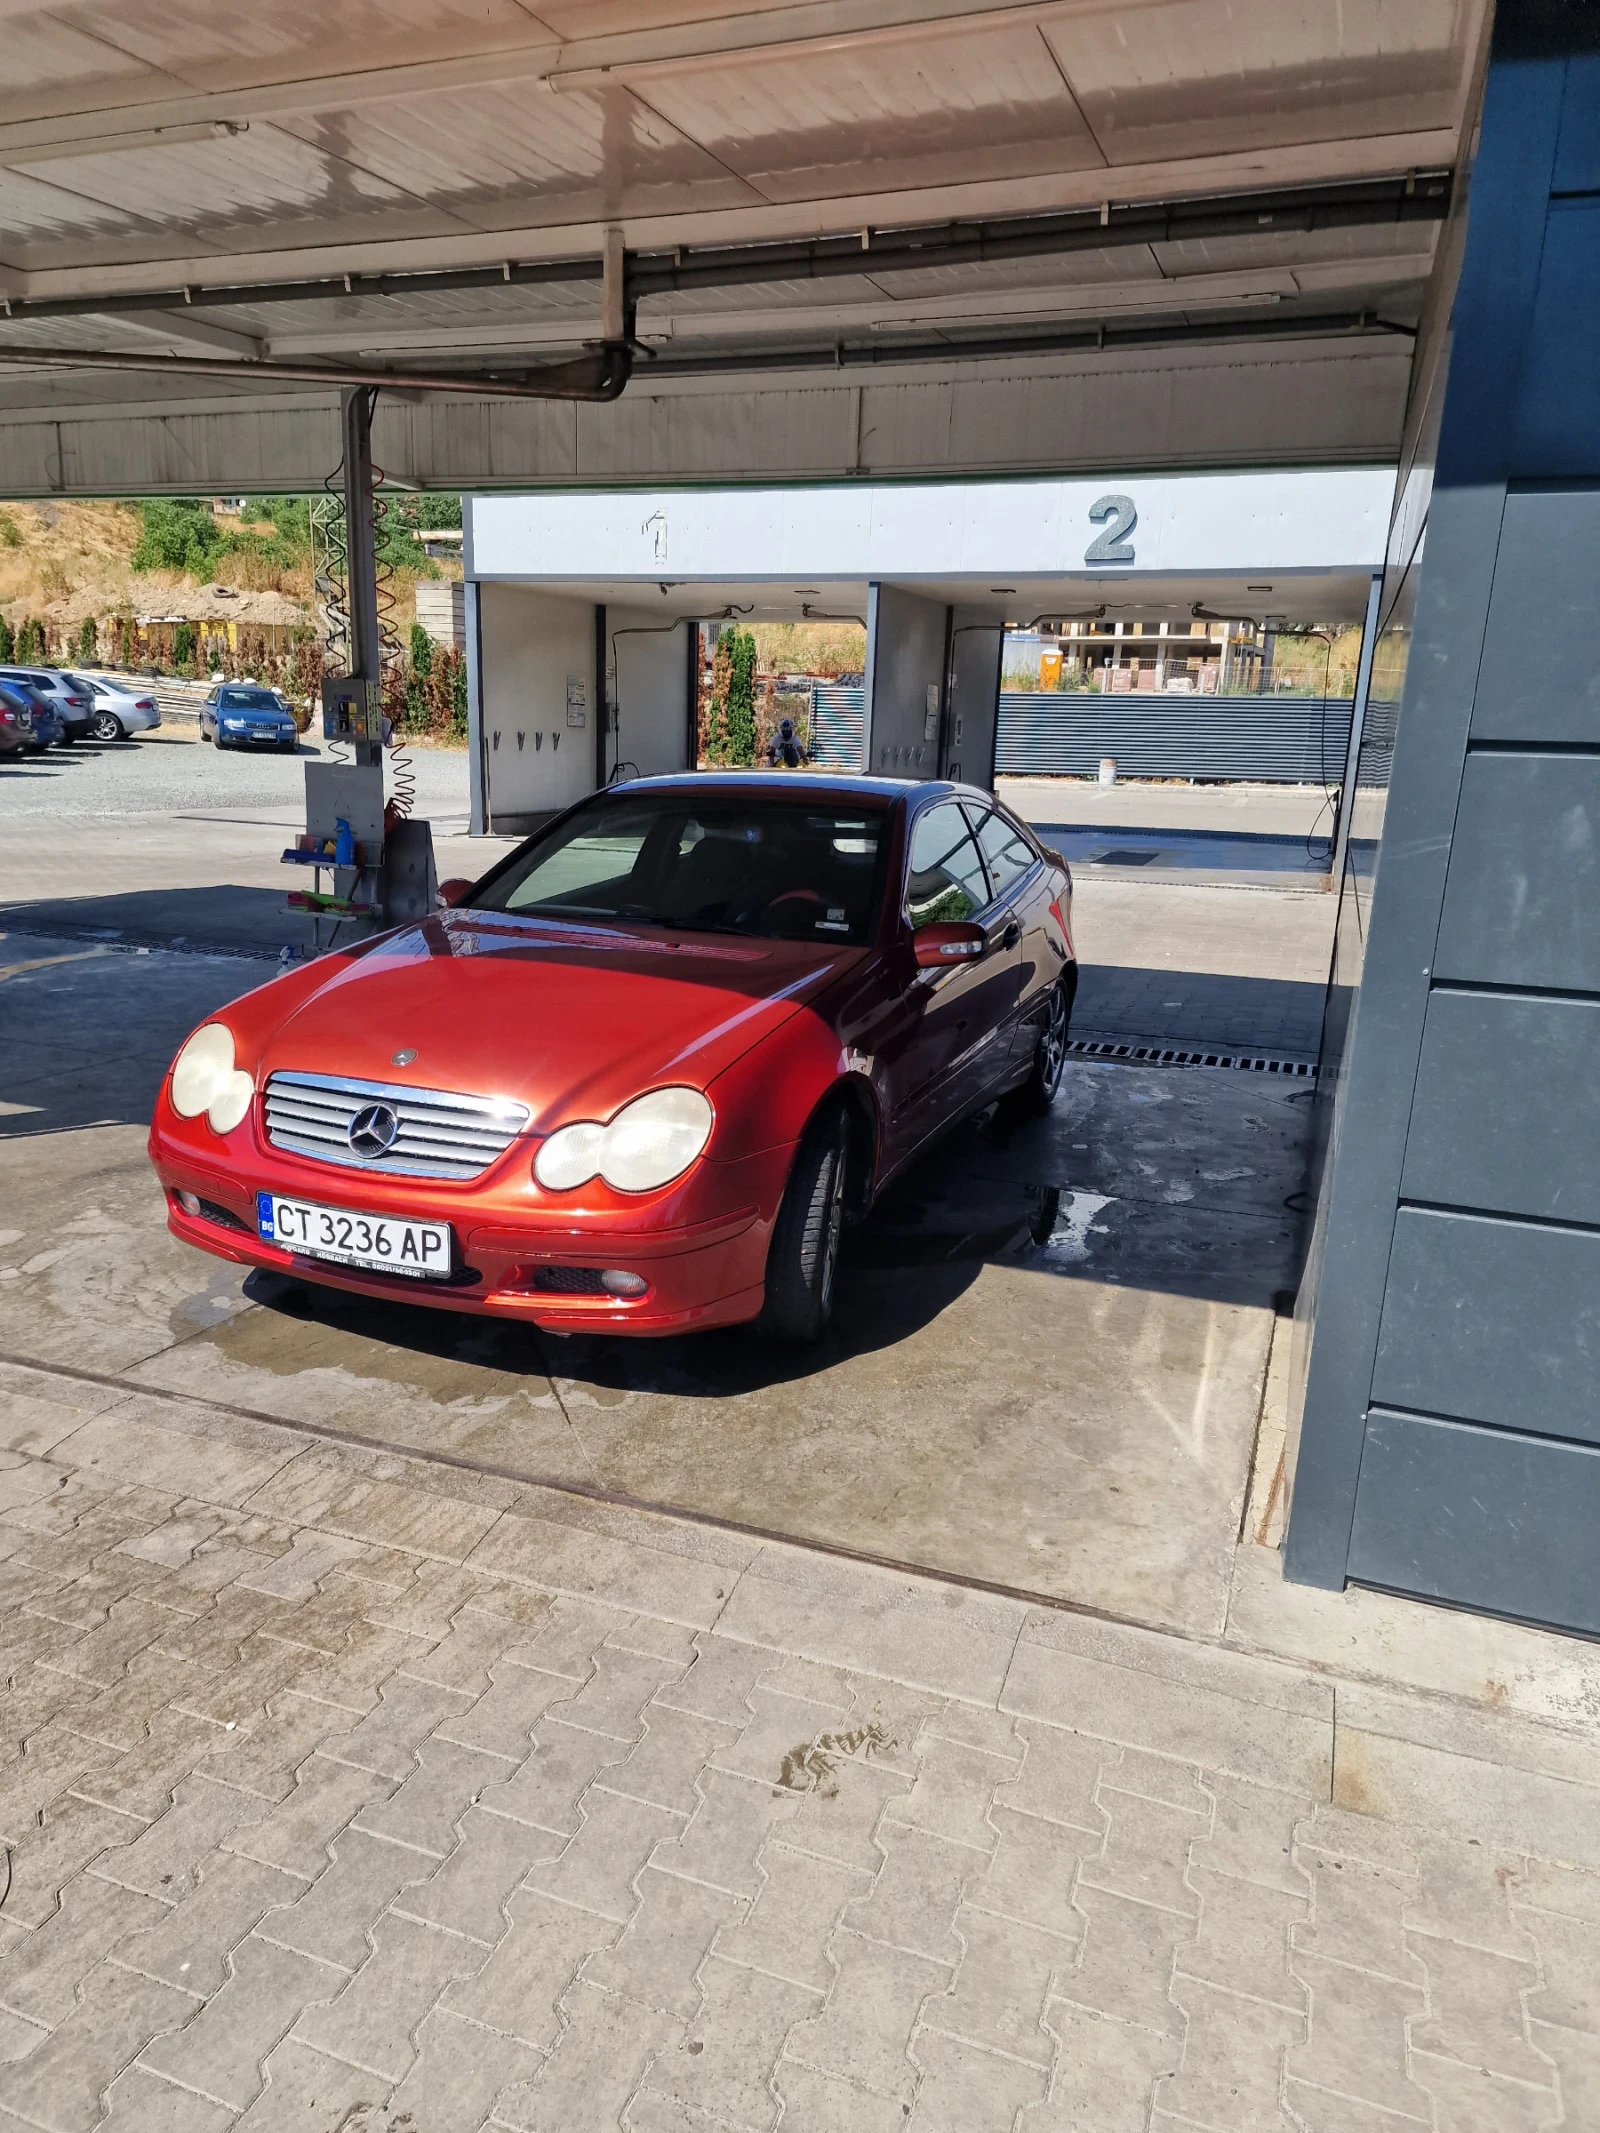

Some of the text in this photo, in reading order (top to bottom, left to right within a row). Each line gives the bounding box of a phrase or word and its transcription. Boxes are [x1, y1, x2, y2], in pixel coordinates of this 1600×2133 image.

[1083, 494, 1137, 566] 2
[261, 1220, 274, 1232] BG
[277, 1203, 442, 1263] CT 3236 AP
